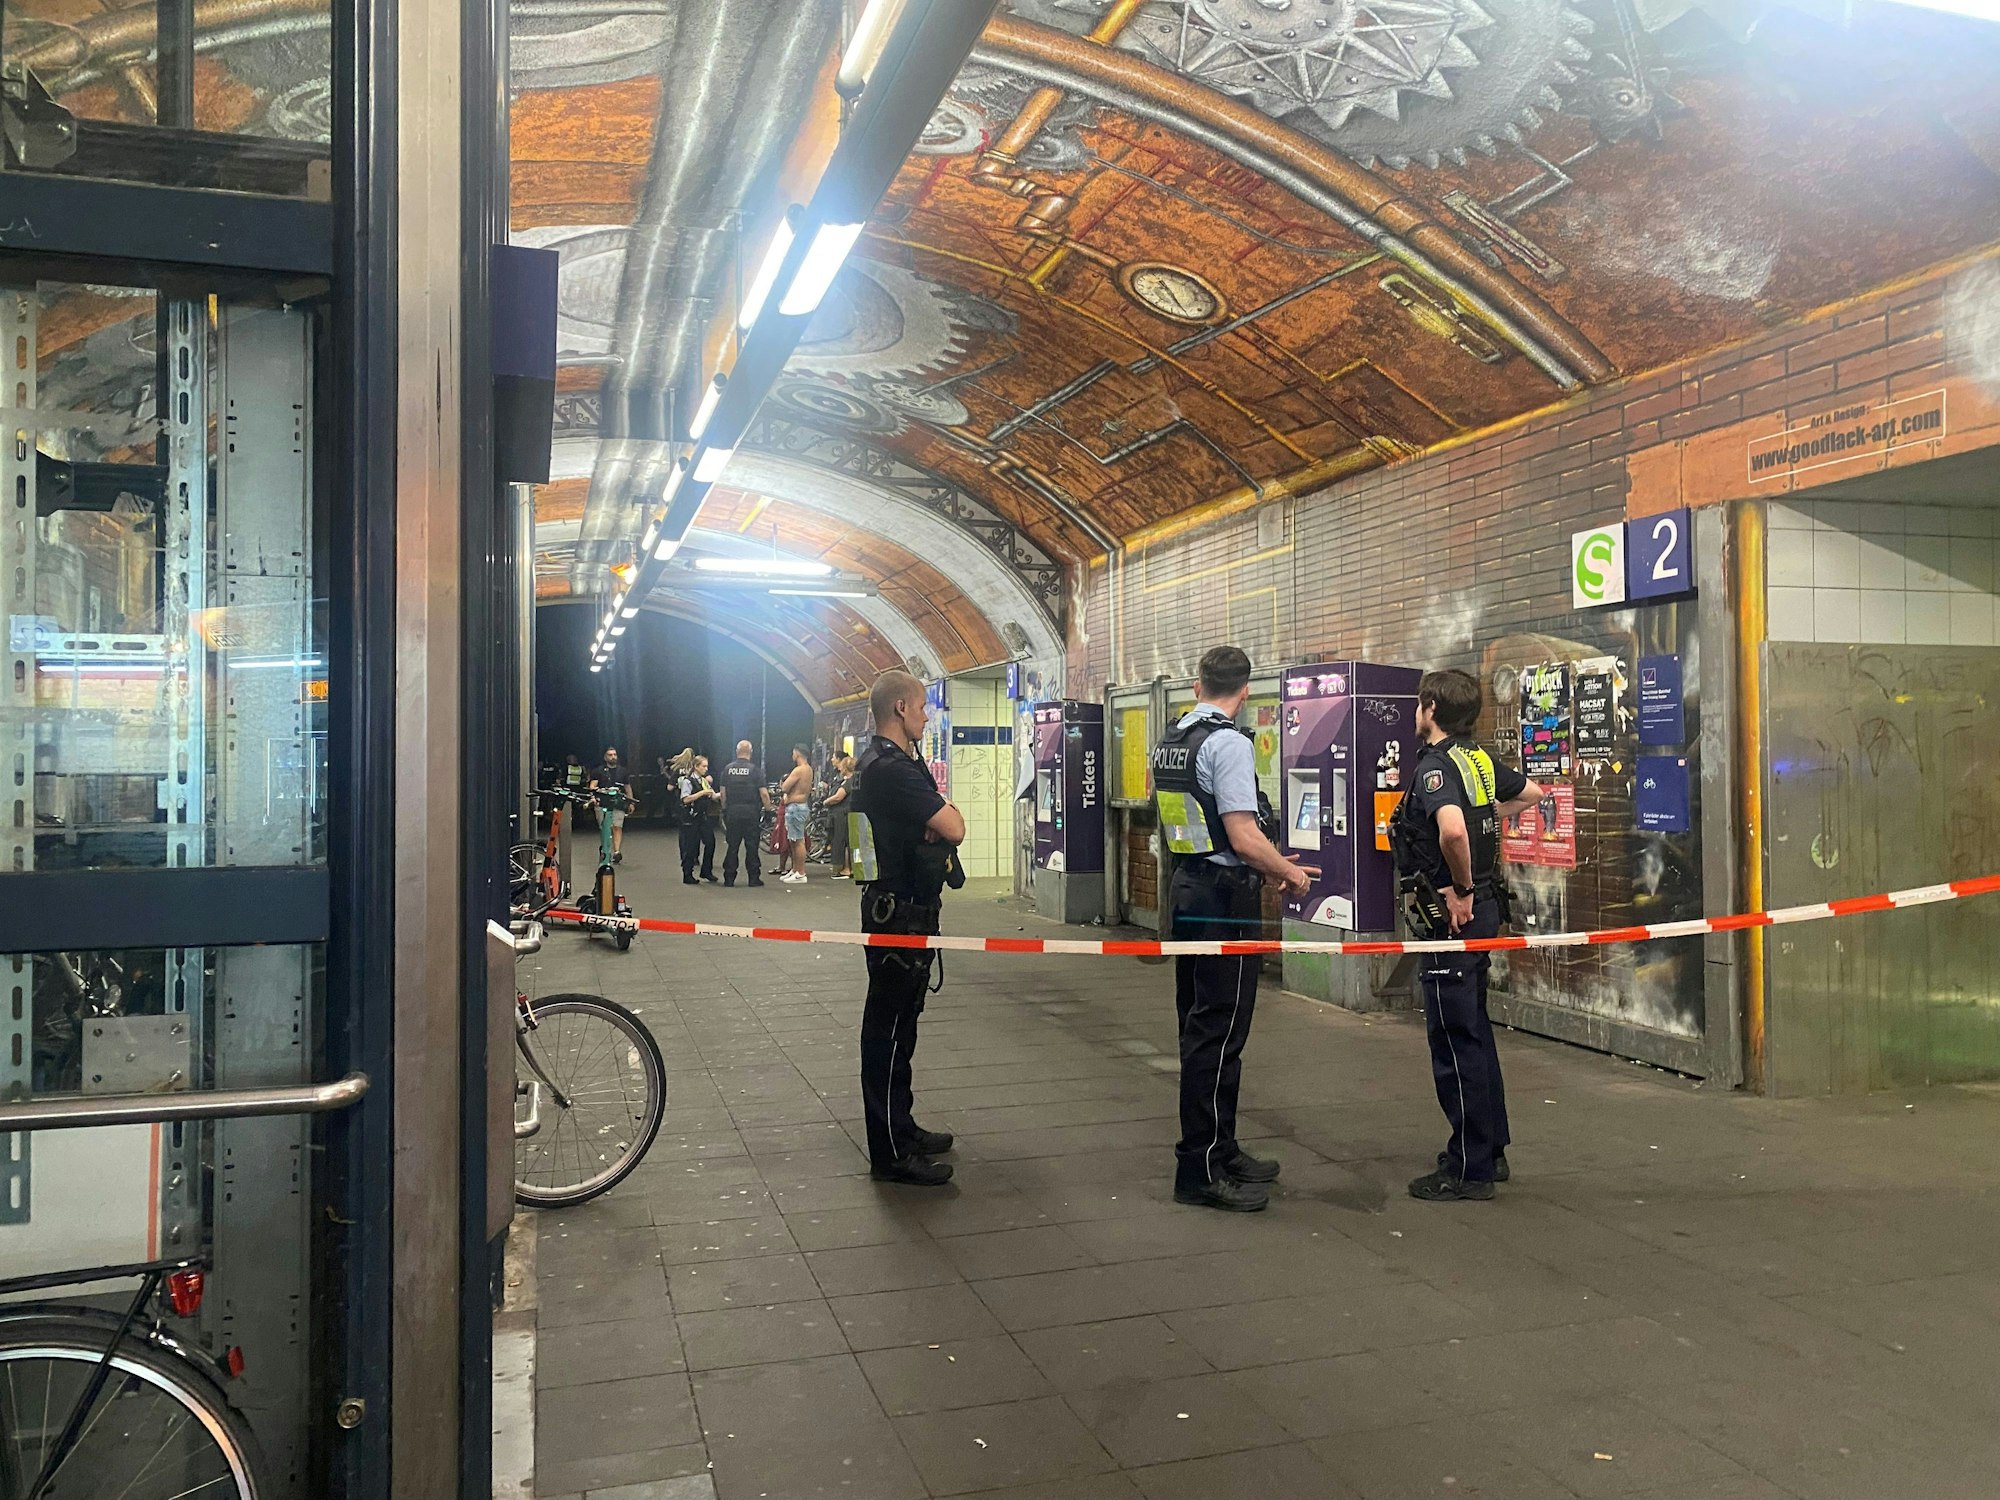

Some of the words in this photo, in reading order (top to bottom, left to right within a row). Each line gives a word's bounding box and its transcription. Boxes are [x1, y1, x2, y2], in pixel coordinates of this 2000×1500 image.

[1652, 518, 1678, 580] 2
[1577, 533, 1616, 599] S
[1008, 668, 1014, 688] 3
[1580, 699, 1606, 709] MACSAT
[1154, 747, 1190, 770] POLIZEI
[728, 767, 749, 776] POLIZEI
[1082, 750, 1095, 808] Tickets
